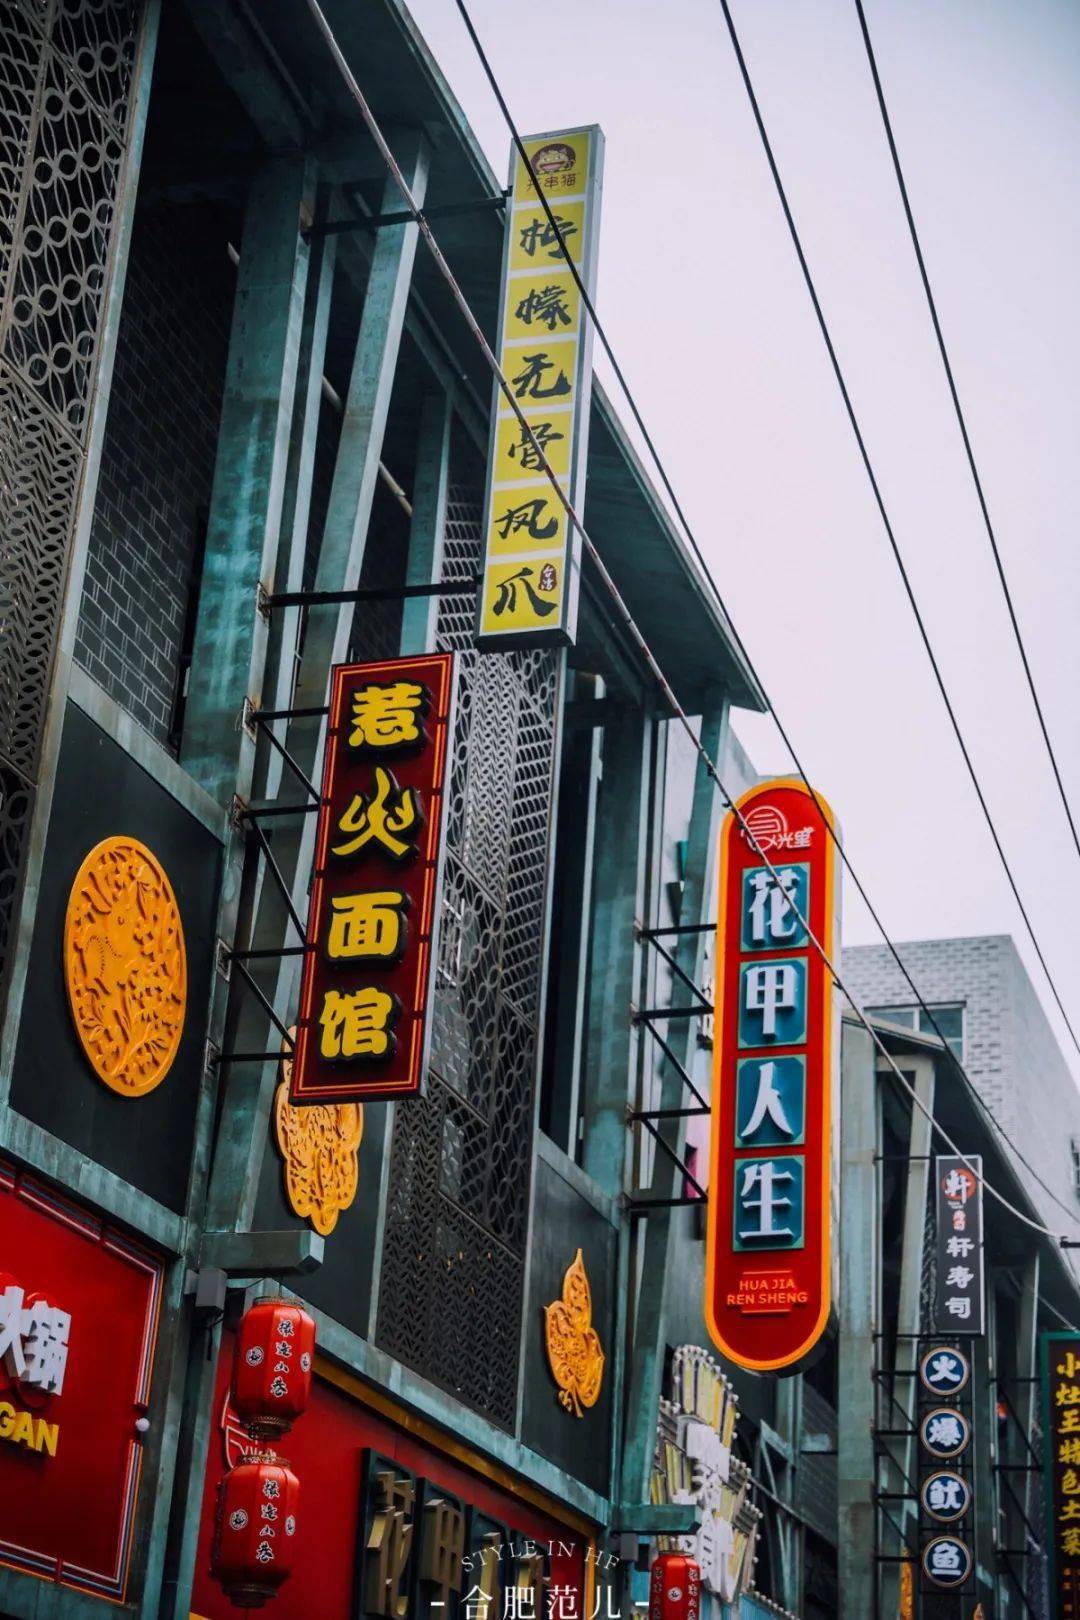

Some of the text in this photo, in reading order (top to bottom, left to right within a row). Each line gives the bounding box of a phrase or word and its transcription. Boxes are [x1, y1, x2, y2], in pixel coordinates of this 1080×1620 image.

[493, 215, 578, 617] 柠檬无骨凤爪
[319, 683, 425, 1059] 惹火面馆
[739, 868, 801, 1239] 花甲人生
[727, 1292, 808, 1305] REN SHENG
[739, 1279, 794, 1291] HUA JIA
